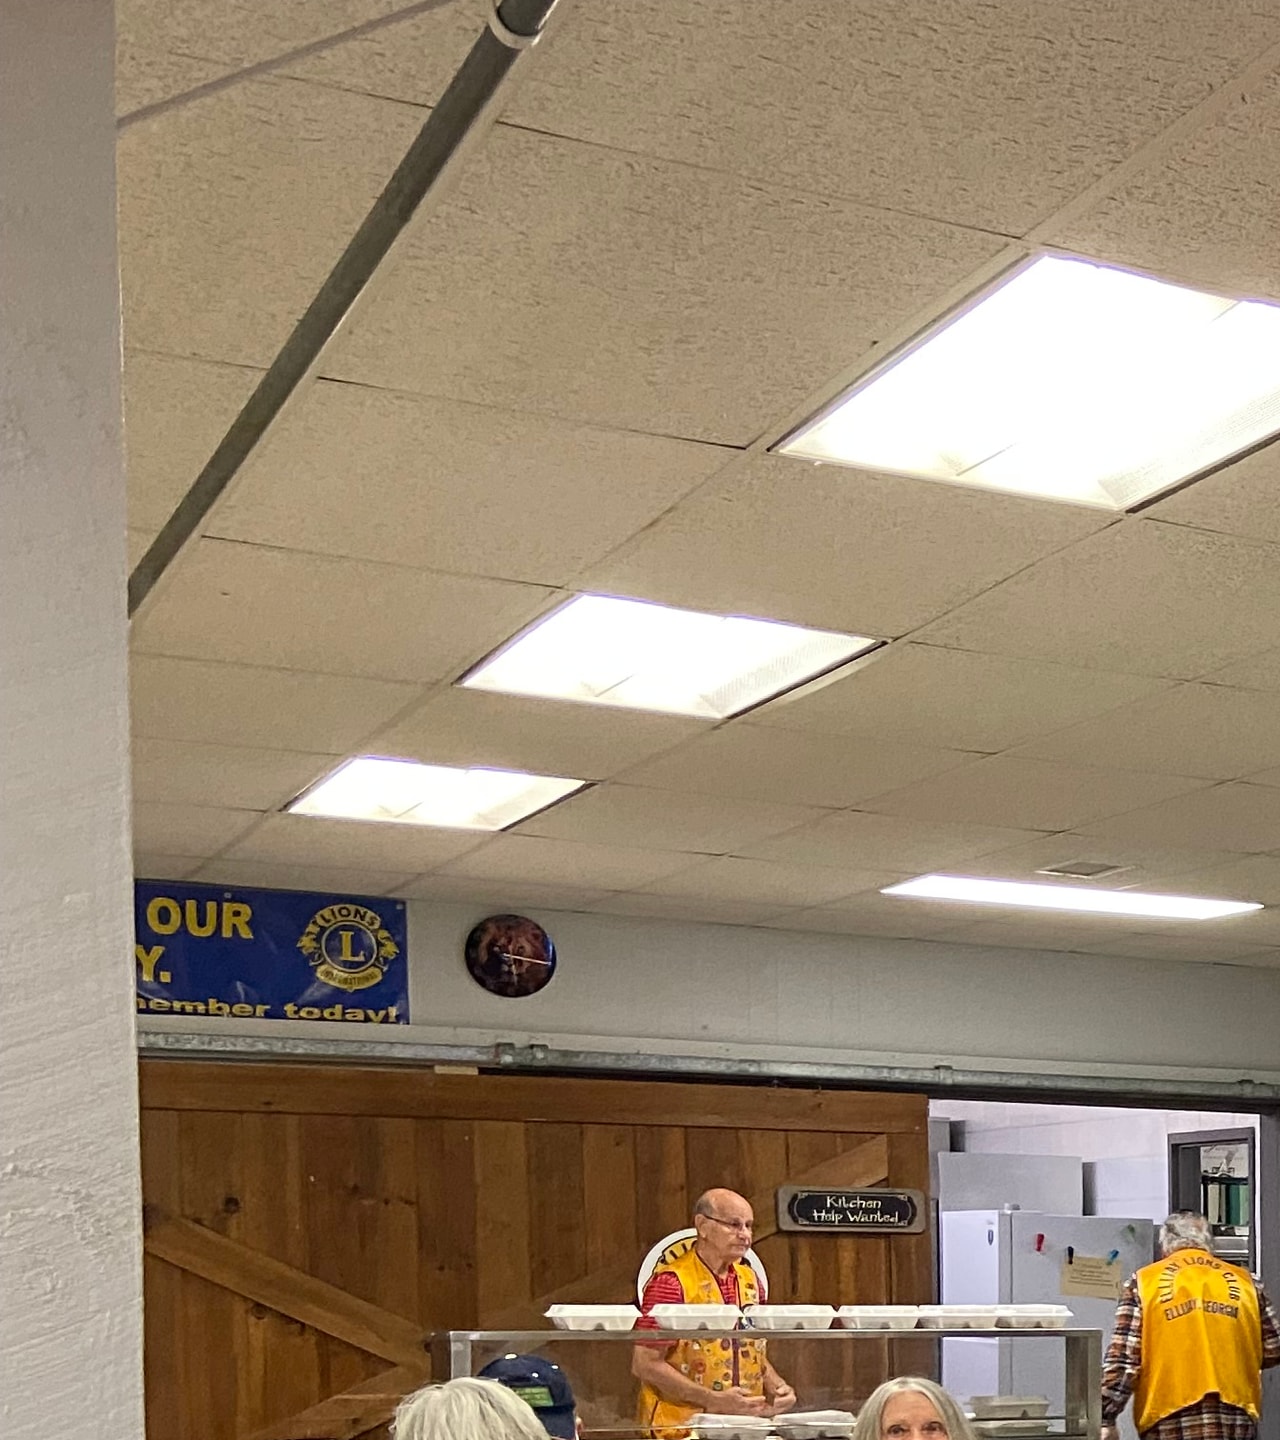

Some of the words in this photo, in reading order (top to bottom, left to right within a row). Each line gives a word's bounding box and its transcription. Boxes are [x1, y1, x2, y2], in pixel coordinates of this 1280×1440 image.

[147, 897, 254, 939] OUR
[320, 906, 379, 927] LIONS
[339, 931, 365, 961] L
[284, 1001, 399, 1024] today!
[826, 1196, 882, 1209] Kitchen
[813, 1209, 843, 1225] Help
[846, 1210, 899, 1223] Wanted
[1183, 1257, 1222, 1270] LIONS
[1222, 1272, 1241, 1302] CLUB
